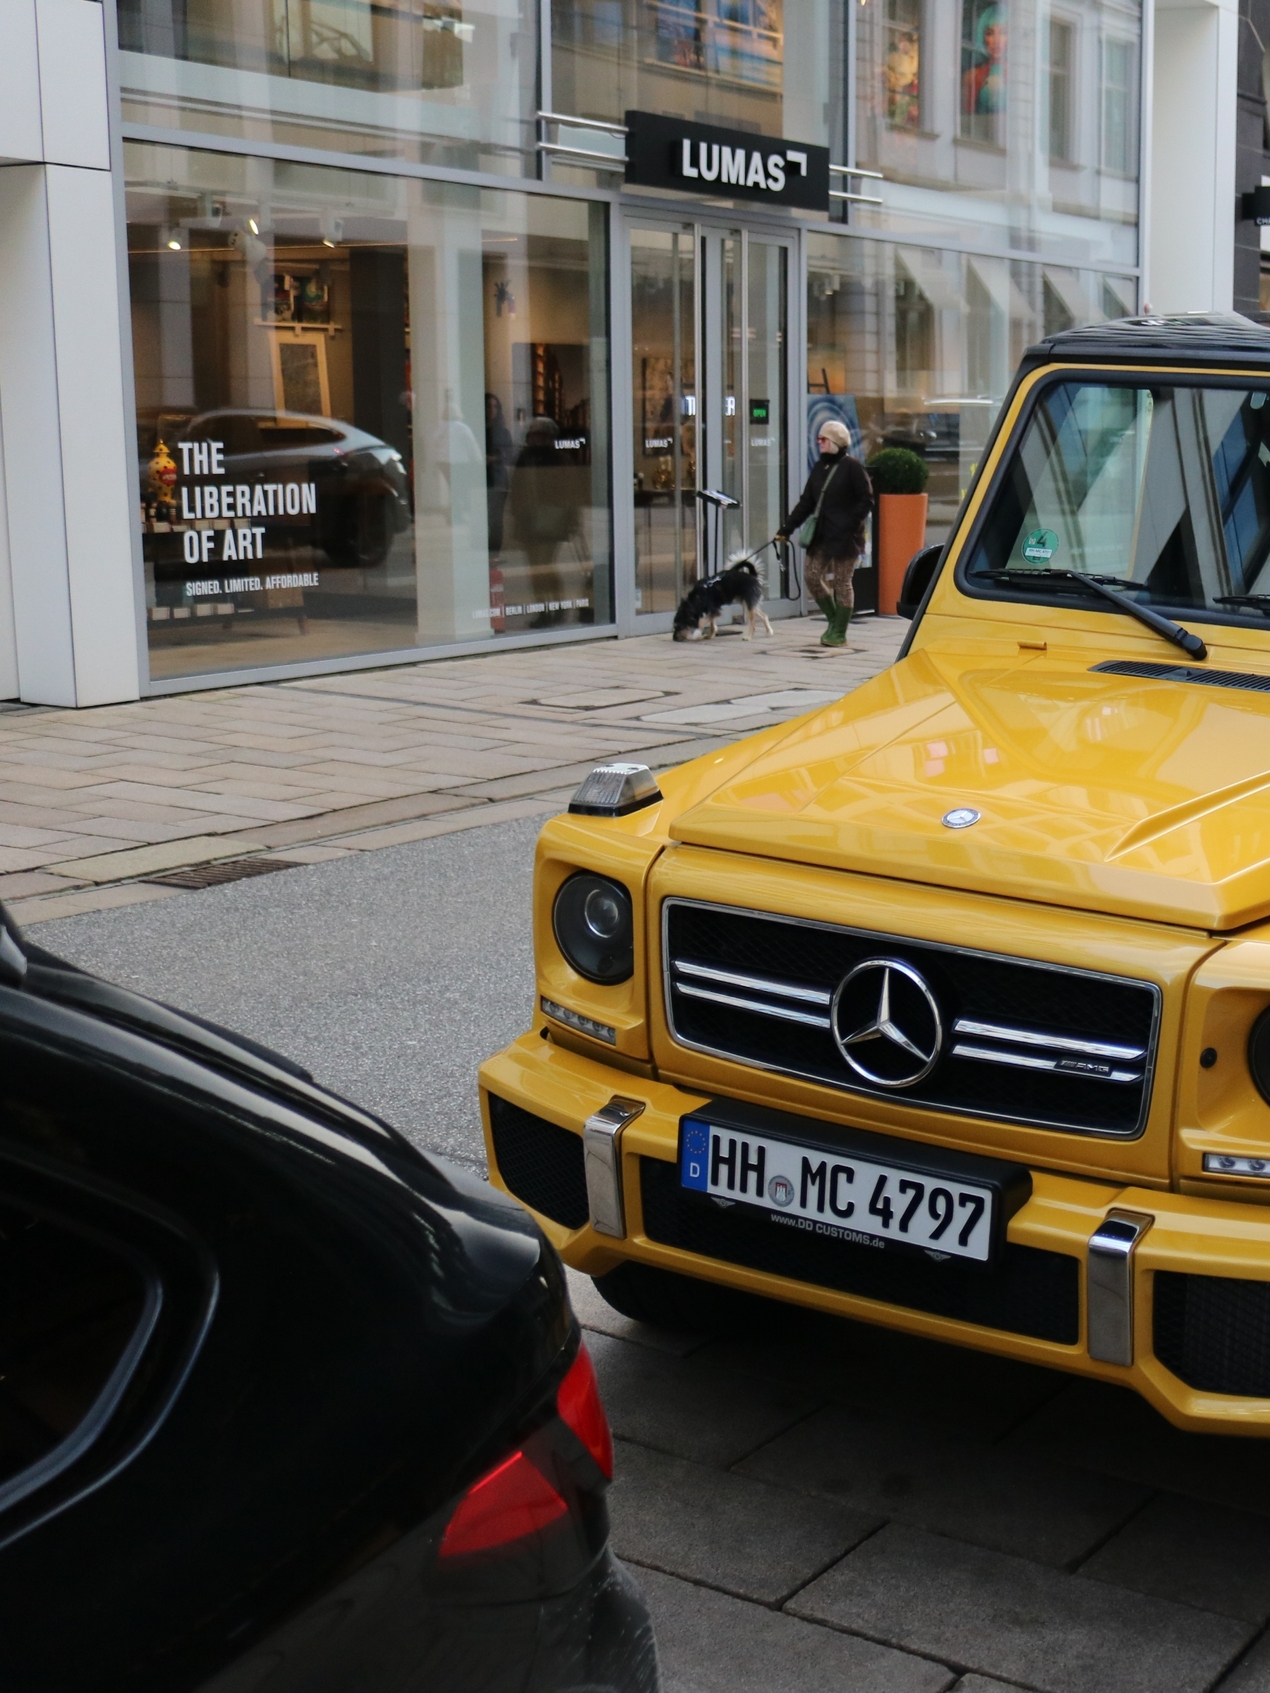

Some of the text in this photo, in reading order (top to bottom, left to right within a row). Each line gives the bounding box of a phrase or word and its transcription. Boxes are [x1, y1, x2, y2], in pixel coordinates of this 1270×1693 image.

[682, 138, 786, 192] LUMAS
[178, 441, 226, 475] THE
[554, 438, 580, 450] LUMAS
[645, 438, 668, 449] LUMAS
[181, 482, 317, 520] LIBERATION
[183, 527, 266, 564] OF ART
[1036, 530, 1049, 548] 4
[185, 572, 320, 597] SIGNED. LIMITED. AFFORDABLE
[688, 1161, 701, 1179] D
[710, 1133, 986, 1248] HH MC 4797
[770, 1212, 886, 1250] www.DD CUSTOMS.de
